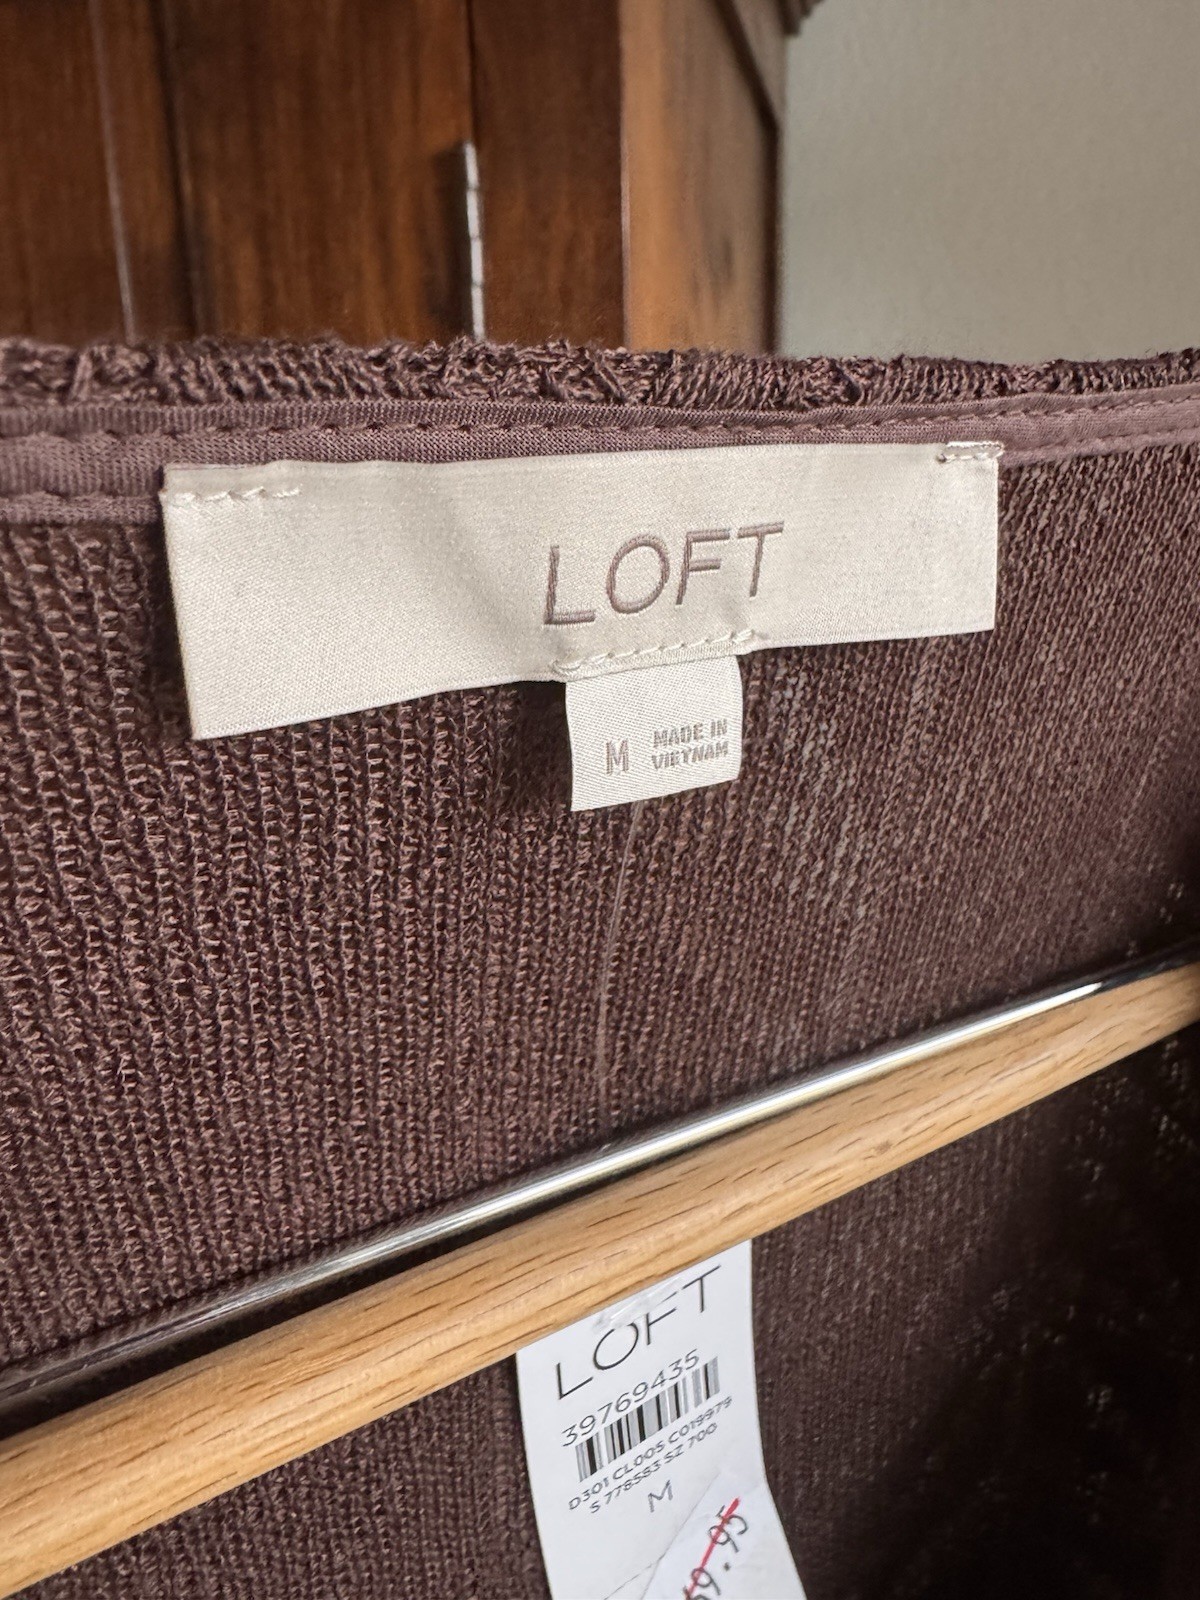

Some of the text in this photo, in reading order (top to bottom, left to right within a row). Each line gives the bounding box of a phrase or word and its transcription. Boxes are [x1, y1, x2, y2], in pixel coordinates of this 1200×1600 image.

[543, 521, 784, 625] LOFT
[605, 739, 630, 775] M
[651, 740, 730, 771] VIETNAM
[653, 718, 729, 749] MADE IN
[555, 1264, 722, 1401] LOFT
[562, 1348, 701, 1448] 39769435
[568, 1476, 610, 1511] D301
[612, 1440, 666, 1481] CL005
[589, 1500, 602, 1514] S
[664, 1444, 685, 1465] SZ
[687, 1422, 718, 1449] 700
[647, 1479, 674, 1513] M
